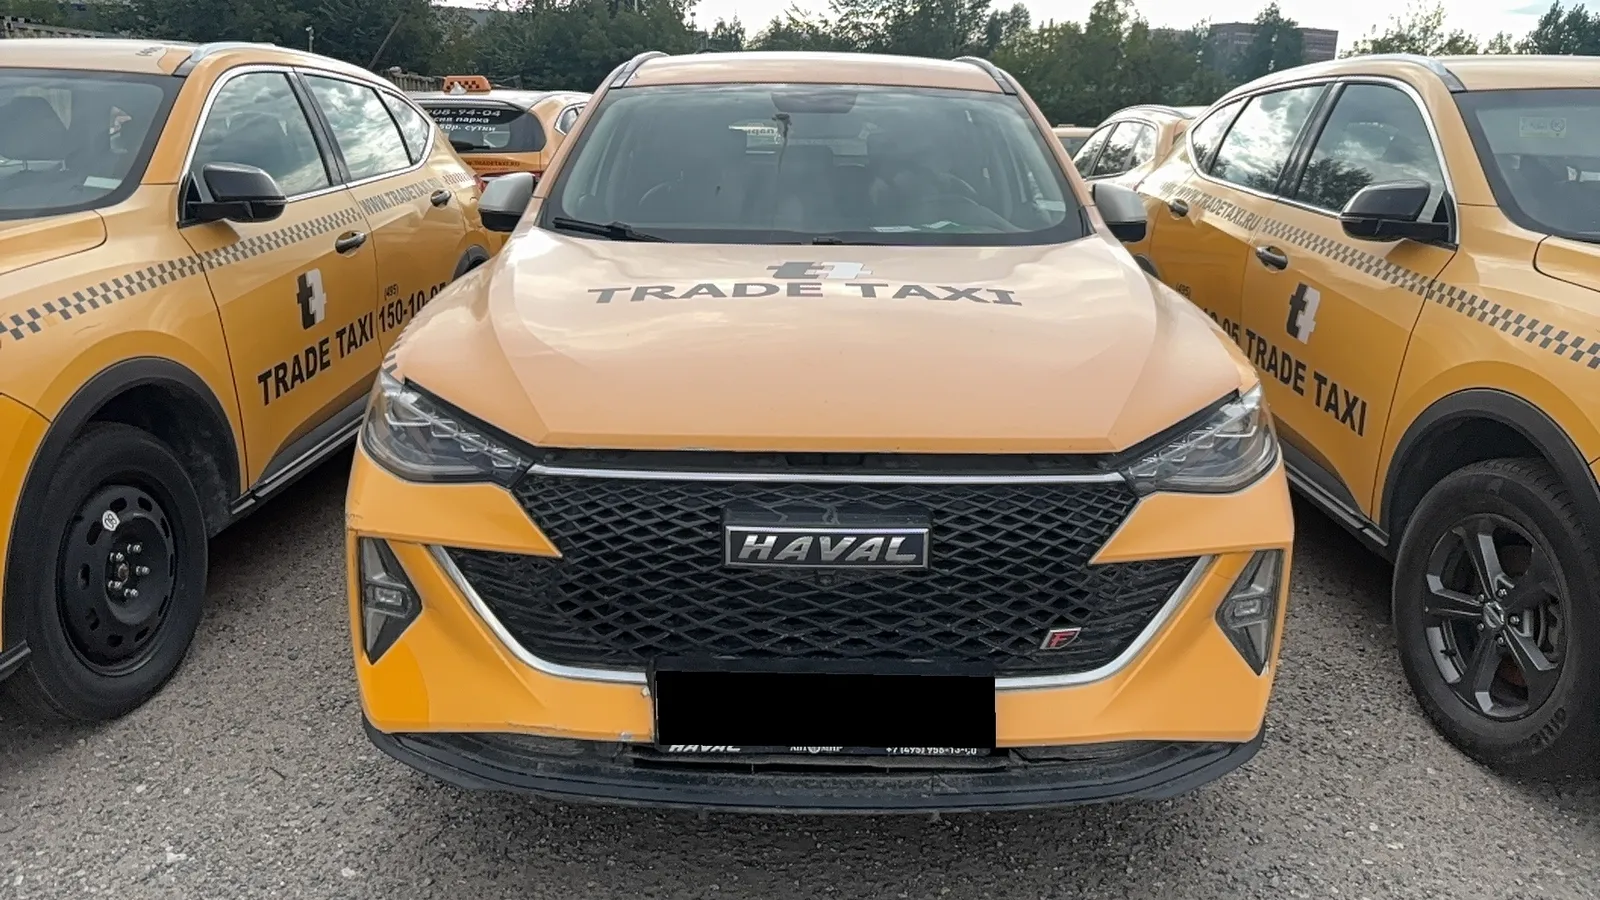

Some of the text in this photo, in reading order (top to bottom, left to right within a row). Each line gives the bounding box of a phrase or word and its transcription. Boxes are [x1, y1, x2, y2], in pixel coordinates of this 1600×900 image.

[587, 282, 1023, 306] TRADE TAXI
[257, 282, 446, 406] TRADE TAXI 150-10-
[1245, 328, 1307, 396] TRADE
[1313, 370, 1367, 437] TAXI
[738, 534, 917, 563] HAVAL
